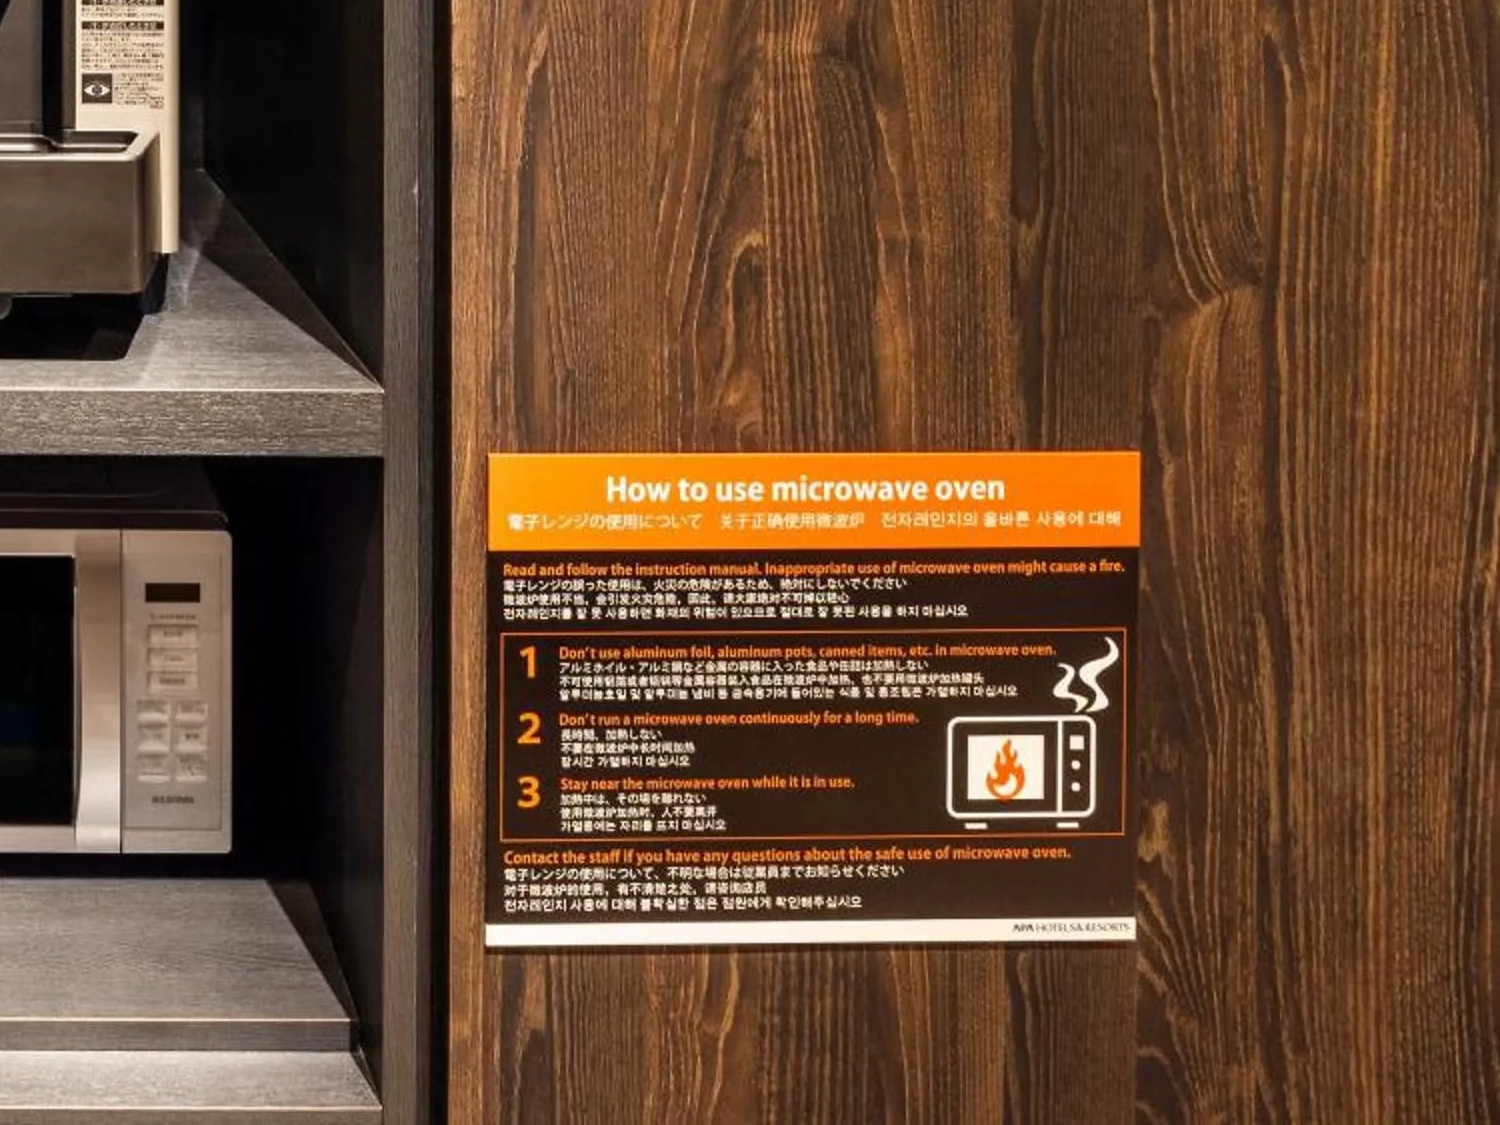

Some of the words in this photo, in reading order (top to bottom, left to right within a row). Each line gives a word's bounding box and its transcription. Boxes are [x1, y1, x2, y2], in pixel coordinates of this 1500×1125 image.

[607, 476, 671, 502] How
[678, 478, 707, 502] to
[715, 483, 764, 502] use
[771, 475, 929, 501] microwave
[935, 480, 1005, 500] oven
[508, 513, 702, 531] 電子レンジの使用について
[881, 511, 977, 528] 전자레인지의
[983, 511, 1029, 528] 올바른
[1037, 511, 1084, 527] 사용에
[1088, 511, 1121, 527] 대해
[503, 564, 536, 576] Read
[539, 564, 564, 576] and
[567, 563, 609, 576] follow
[611, 563, 632, 575] the
[636, 563, 706, 575] instruction
[709, 563, 763, 575] manual.
[765, 563, 855, 577] Inappropriate
[858, 564, 880, 574] use
[883, 562, 897, 574] of
[900, 561, 972, 574] microwave
[973, 563, 1005, 573] oven
[1007, 560, 1046, 576] might
[1050, 562, 1086, 572] cause
[1089, 562, 1095, 572] a
[1100, 559, 1125, 572] fire.
[559, 647, 596, 659] Don't
[600, 649, 620, 659] use
[623, 647, 688, 659] aluminum
[690, 645, 715, 659] foil,
[718, 646, 782, 657] aluminum
[784, 646, 816, 660] pots,
[819, 645, 865, 657] canned
[868, 645, 907, 658] items,
[909, 645, 932, 656] etc.
[935, 644, 947, 656] in
[949, 644, 1018, 656] microwave
[1022, 645, 1056, 656] oven.
[519, 645, 536, 678] 1
[559, 713, 596, 726] Don't
[598, 716, 620, 726] run
[623, 716, 630, 725] a
[634, 713, 703, 725] microwave
[705, 714, 736, 724] oven
[740, 711, 820, 727] continuously
[823, 712, 842, 724] for
[845, 714, 852, 724] a
[855, 711, 884, 726] long
[887, 711, 919, 724] time.
[517, 712, 541, 745] 2
[517, 776, 541, 808] 3
[560, 778, 589, 792] Stay
[591, 780, 619, 789] near
[622, 778, 642, 789] the
[645, 777, 715, 789] microwave
[718, 779, 749, 788] oven
[752, 776, 786, 788] while
[789, 776, 799, 788] it
[801, 776, 811, 788] is
[814, 776, 827, 788] in
[830, 778, 855, 788] use.
[504, 850, 559, 864] Contact
[562, 851, 585, 864] the
[589, 850, 620, 864] staff
[623, 849, 634, 863] if
[637, 853, 662, 866] you
[665, 850, 700, 863] have
[702, 852, 729, 865] any
[732, 849, 801, 864] questions
[804, 848, 845, 860] about
[849, 848, 873, 860] the
[875, 847, 904, 860] safe
[907, 849, 931, 860] use
[935, 846, 949, 859] of
[953, 846, 1029, 859] microwave
[1032, 848, 1071, 859] oven.
[1012, 924, 1034, 932] APA
